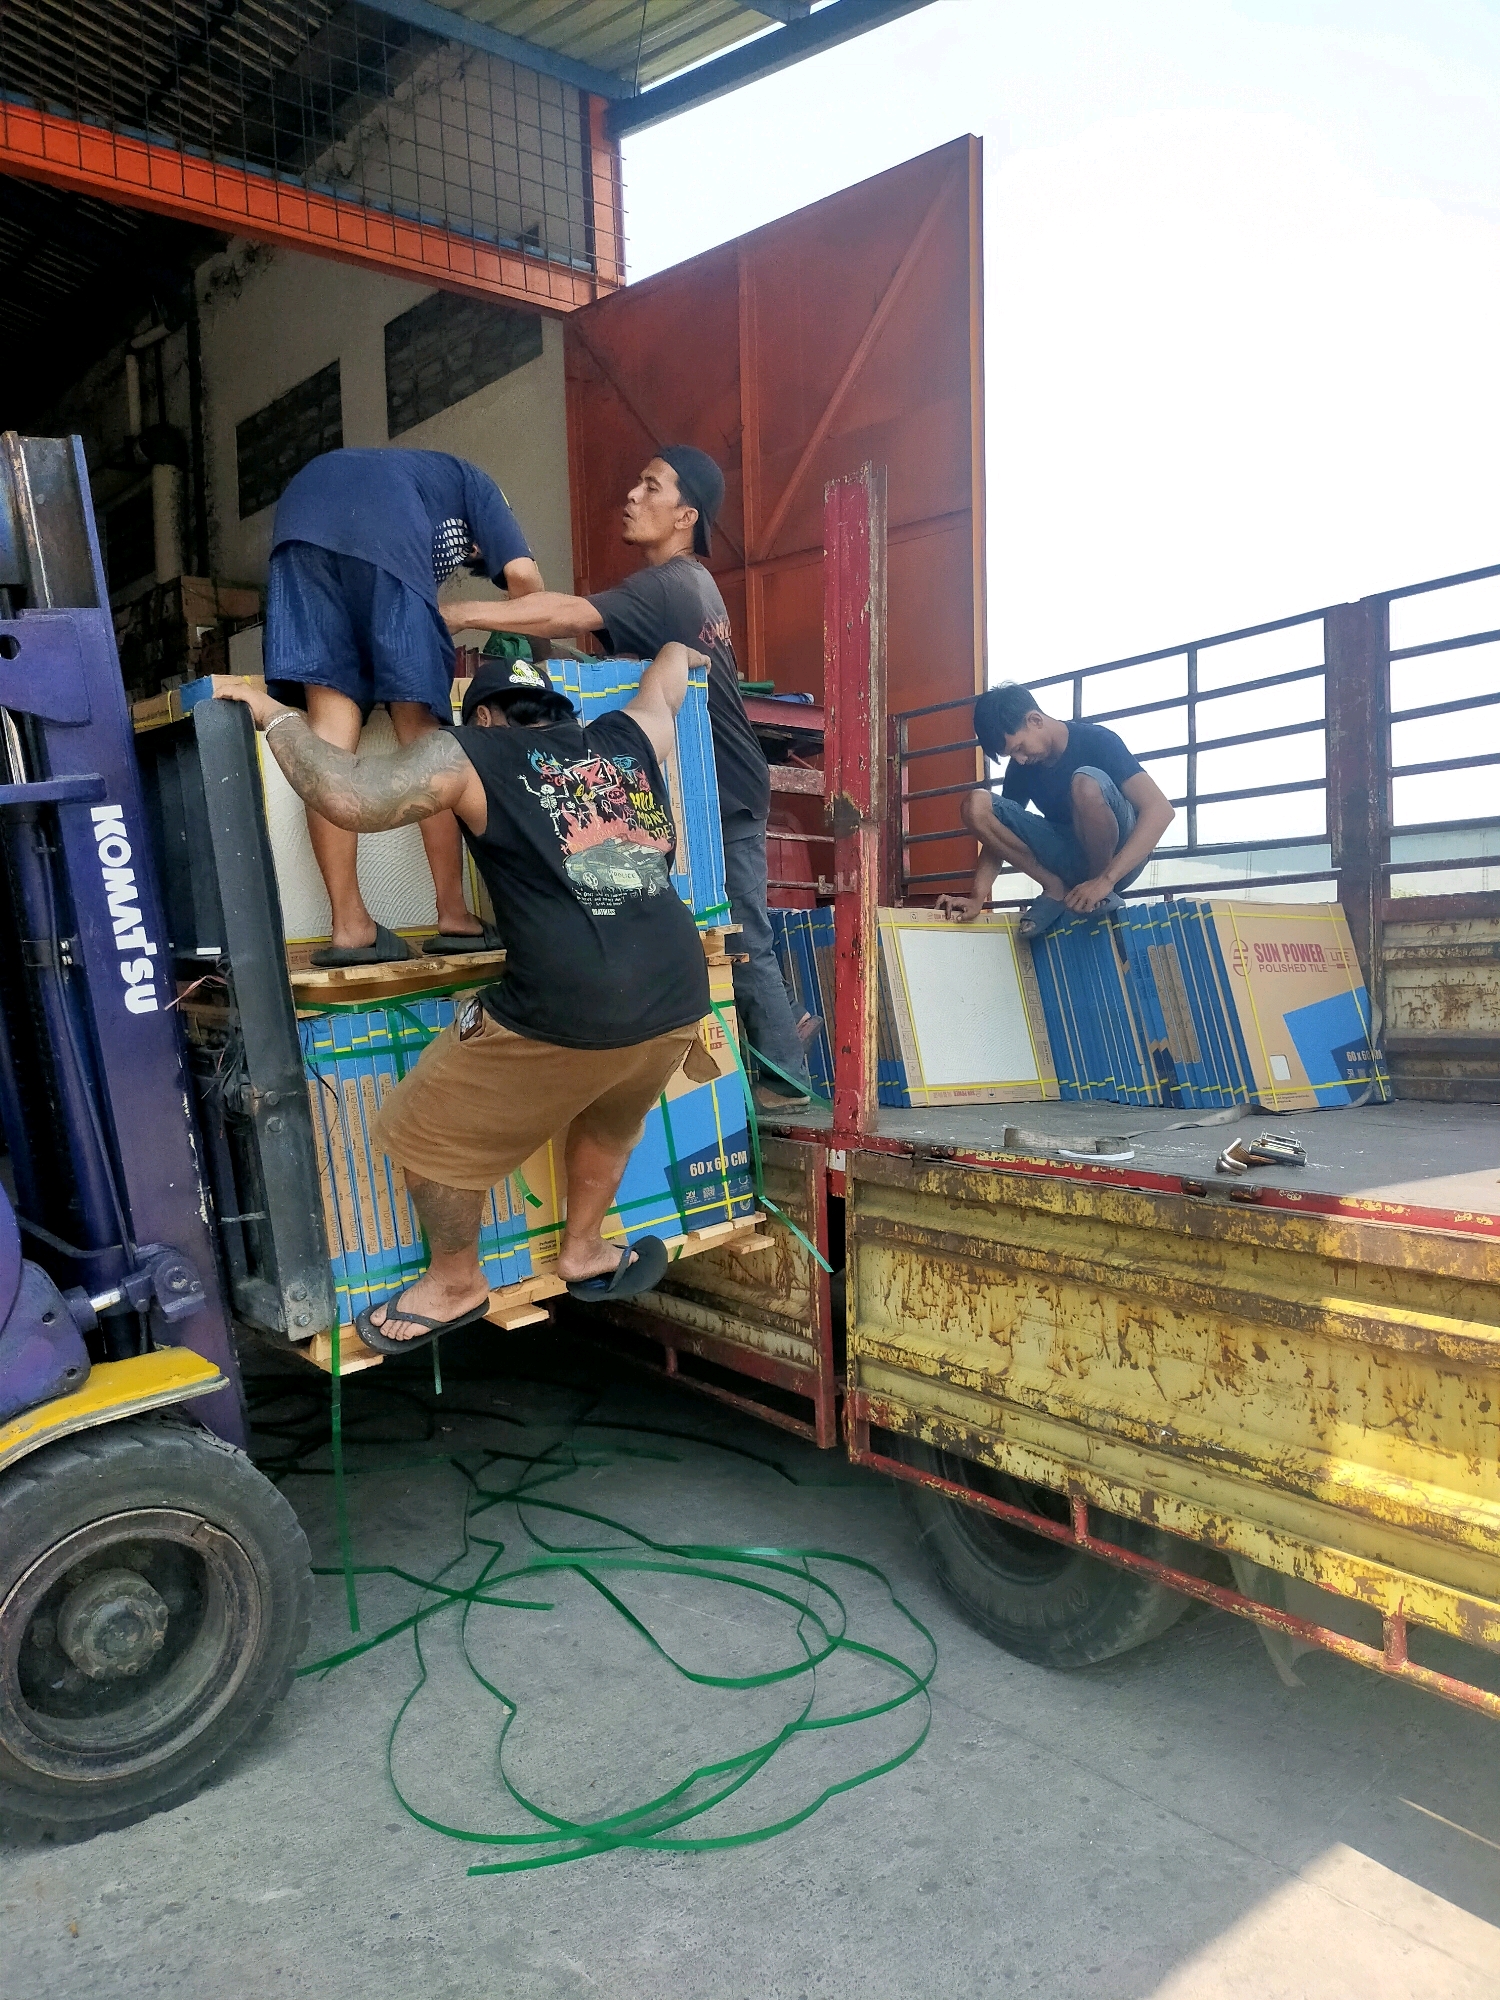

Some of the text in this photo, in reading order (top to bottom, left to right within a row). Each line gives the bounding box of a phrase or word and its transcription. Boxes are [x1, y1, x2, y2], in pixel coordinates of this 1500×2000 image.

[637, 804, 668, 829] MANY
[90, 804, 158, 1015] KOMATSU
[1253, 942, 1350, 963] SUN POWER LITE
[1259, 963, 1307, 973] POLISHED
[1308, 963, 1329, 973] TILE
[702, 1026, 726, 1042] ITE
[1346, 1051, 1358, 1062] 60
[357, 1146, 366, 1164] 957
[690, 1161, 705, 1177] 60
[714, 1155, 730, 1171] 60
[730, 1150, 748, 1167] CM
[361, 1174, 369, 1183] N
[378, 1169, 385, 1177] N
[380, 1187, 387, 1195] A
[367, 1212, 378, 1254] PS6000L
[383, 1204, 395, 1249] PS6000L
[402, 1202, 412, 1246] PS6000L
